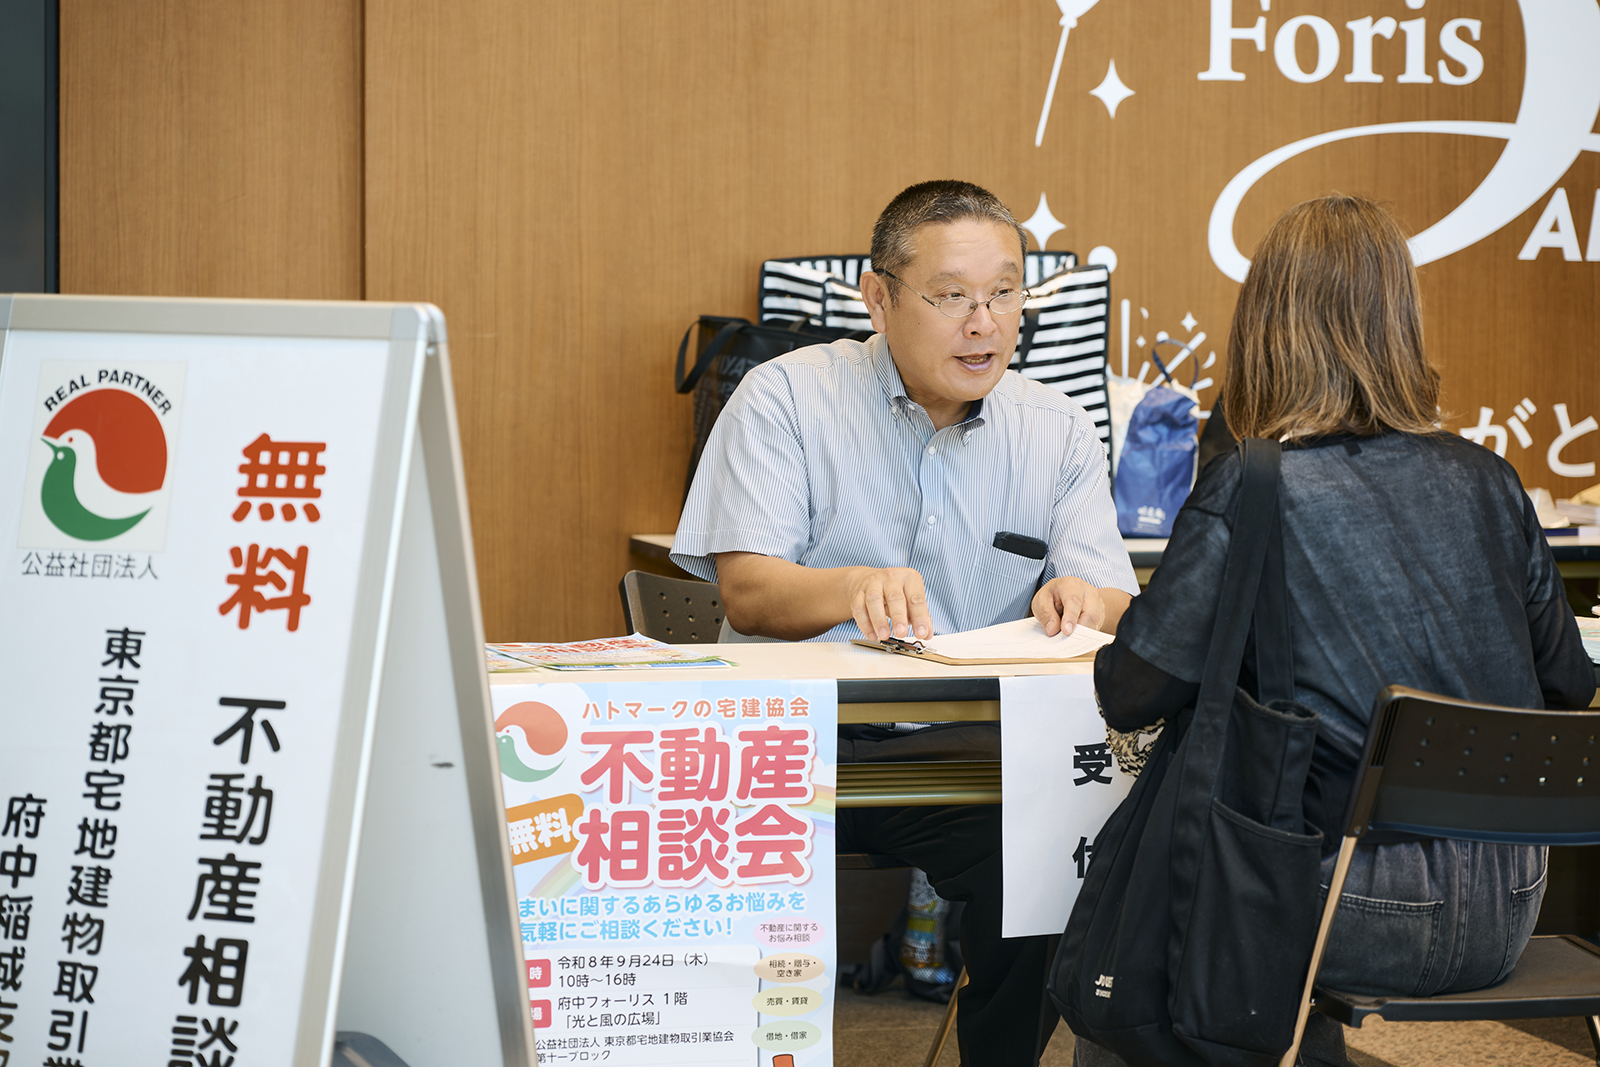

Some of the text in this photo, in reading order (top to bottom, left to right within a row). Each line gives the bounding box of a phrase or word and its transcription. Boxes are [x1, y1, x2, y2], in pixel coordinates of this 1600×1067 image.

[1197, 0, 1484, 86] Foris
[1517, 187, 1600, 261] A
[44, 369, 172, 415] REAL PARTNER
[1434, 397, 1599, 478] がと
[218, 432, 327, 633] 無料
[22, 552, 159, 580] 公益社団法人
[582, 696, 810, 720] ハトマークの宅建協会
[580, 725, 810, 804] 不動産
[43, 627, 146, 1067] 東京都宅地建物取引
[507, 807, 572, 856] 無料
[577, 803, 809, 883] 相談会
[760, 923, 818, 932] 不動産に関する
[768, 933, 810, 942] お悩み相談
[776, 969, 802, 978] 空き家
[557, 993, 655, 1011] 府中フォーリス
[566, 1011, 661, 1029] 「光と風の広場」
[766, 997, 808, 1006] 売買・賃貸
[536, 1030, 734, 1051] 公益社団法人 東京都宅地建物取引業協会
